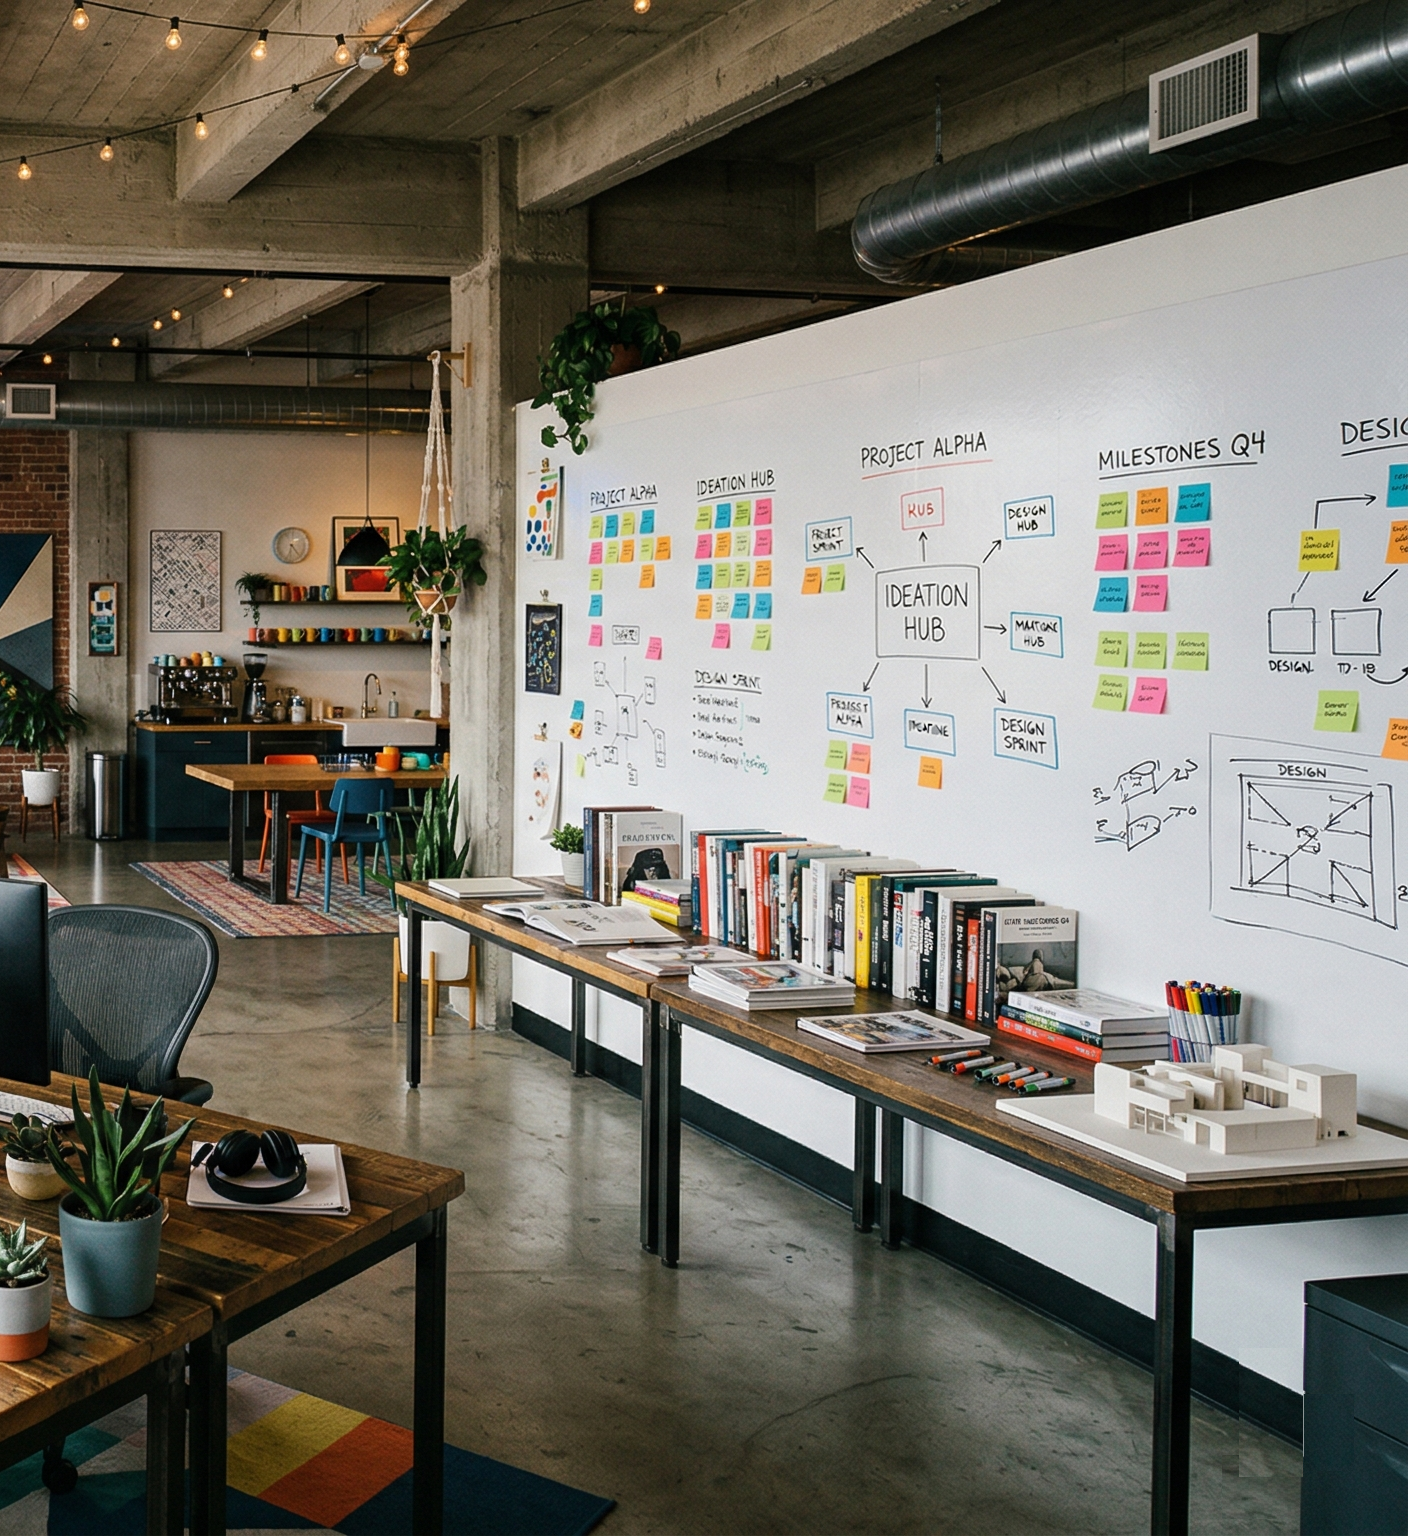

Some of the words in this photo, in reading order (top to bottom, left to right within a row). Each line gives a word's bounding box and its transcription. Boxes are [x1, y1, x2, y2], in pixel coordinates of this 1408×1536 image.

[861, 440, 925, 469] PROJECT
[933, 431, 988, 458] ALPHA
[1099, 437, 1221, 471] MILESTONES
[1231, 430, 1266, 458] Q4
[696, 474, 746, 497] IDEATION
[751, 469, 775, 489] HUB
[1017, 519, 1039, 532] HUB
[885, 582, 968, 608] IDEATION
[904, 616, 946, 643] HUB
[1001, 717, 1045, 737] DESIGN
[1004, 735, 1047, 755] SPRINT
[1277, 763, 1327, 779] DESIGN
